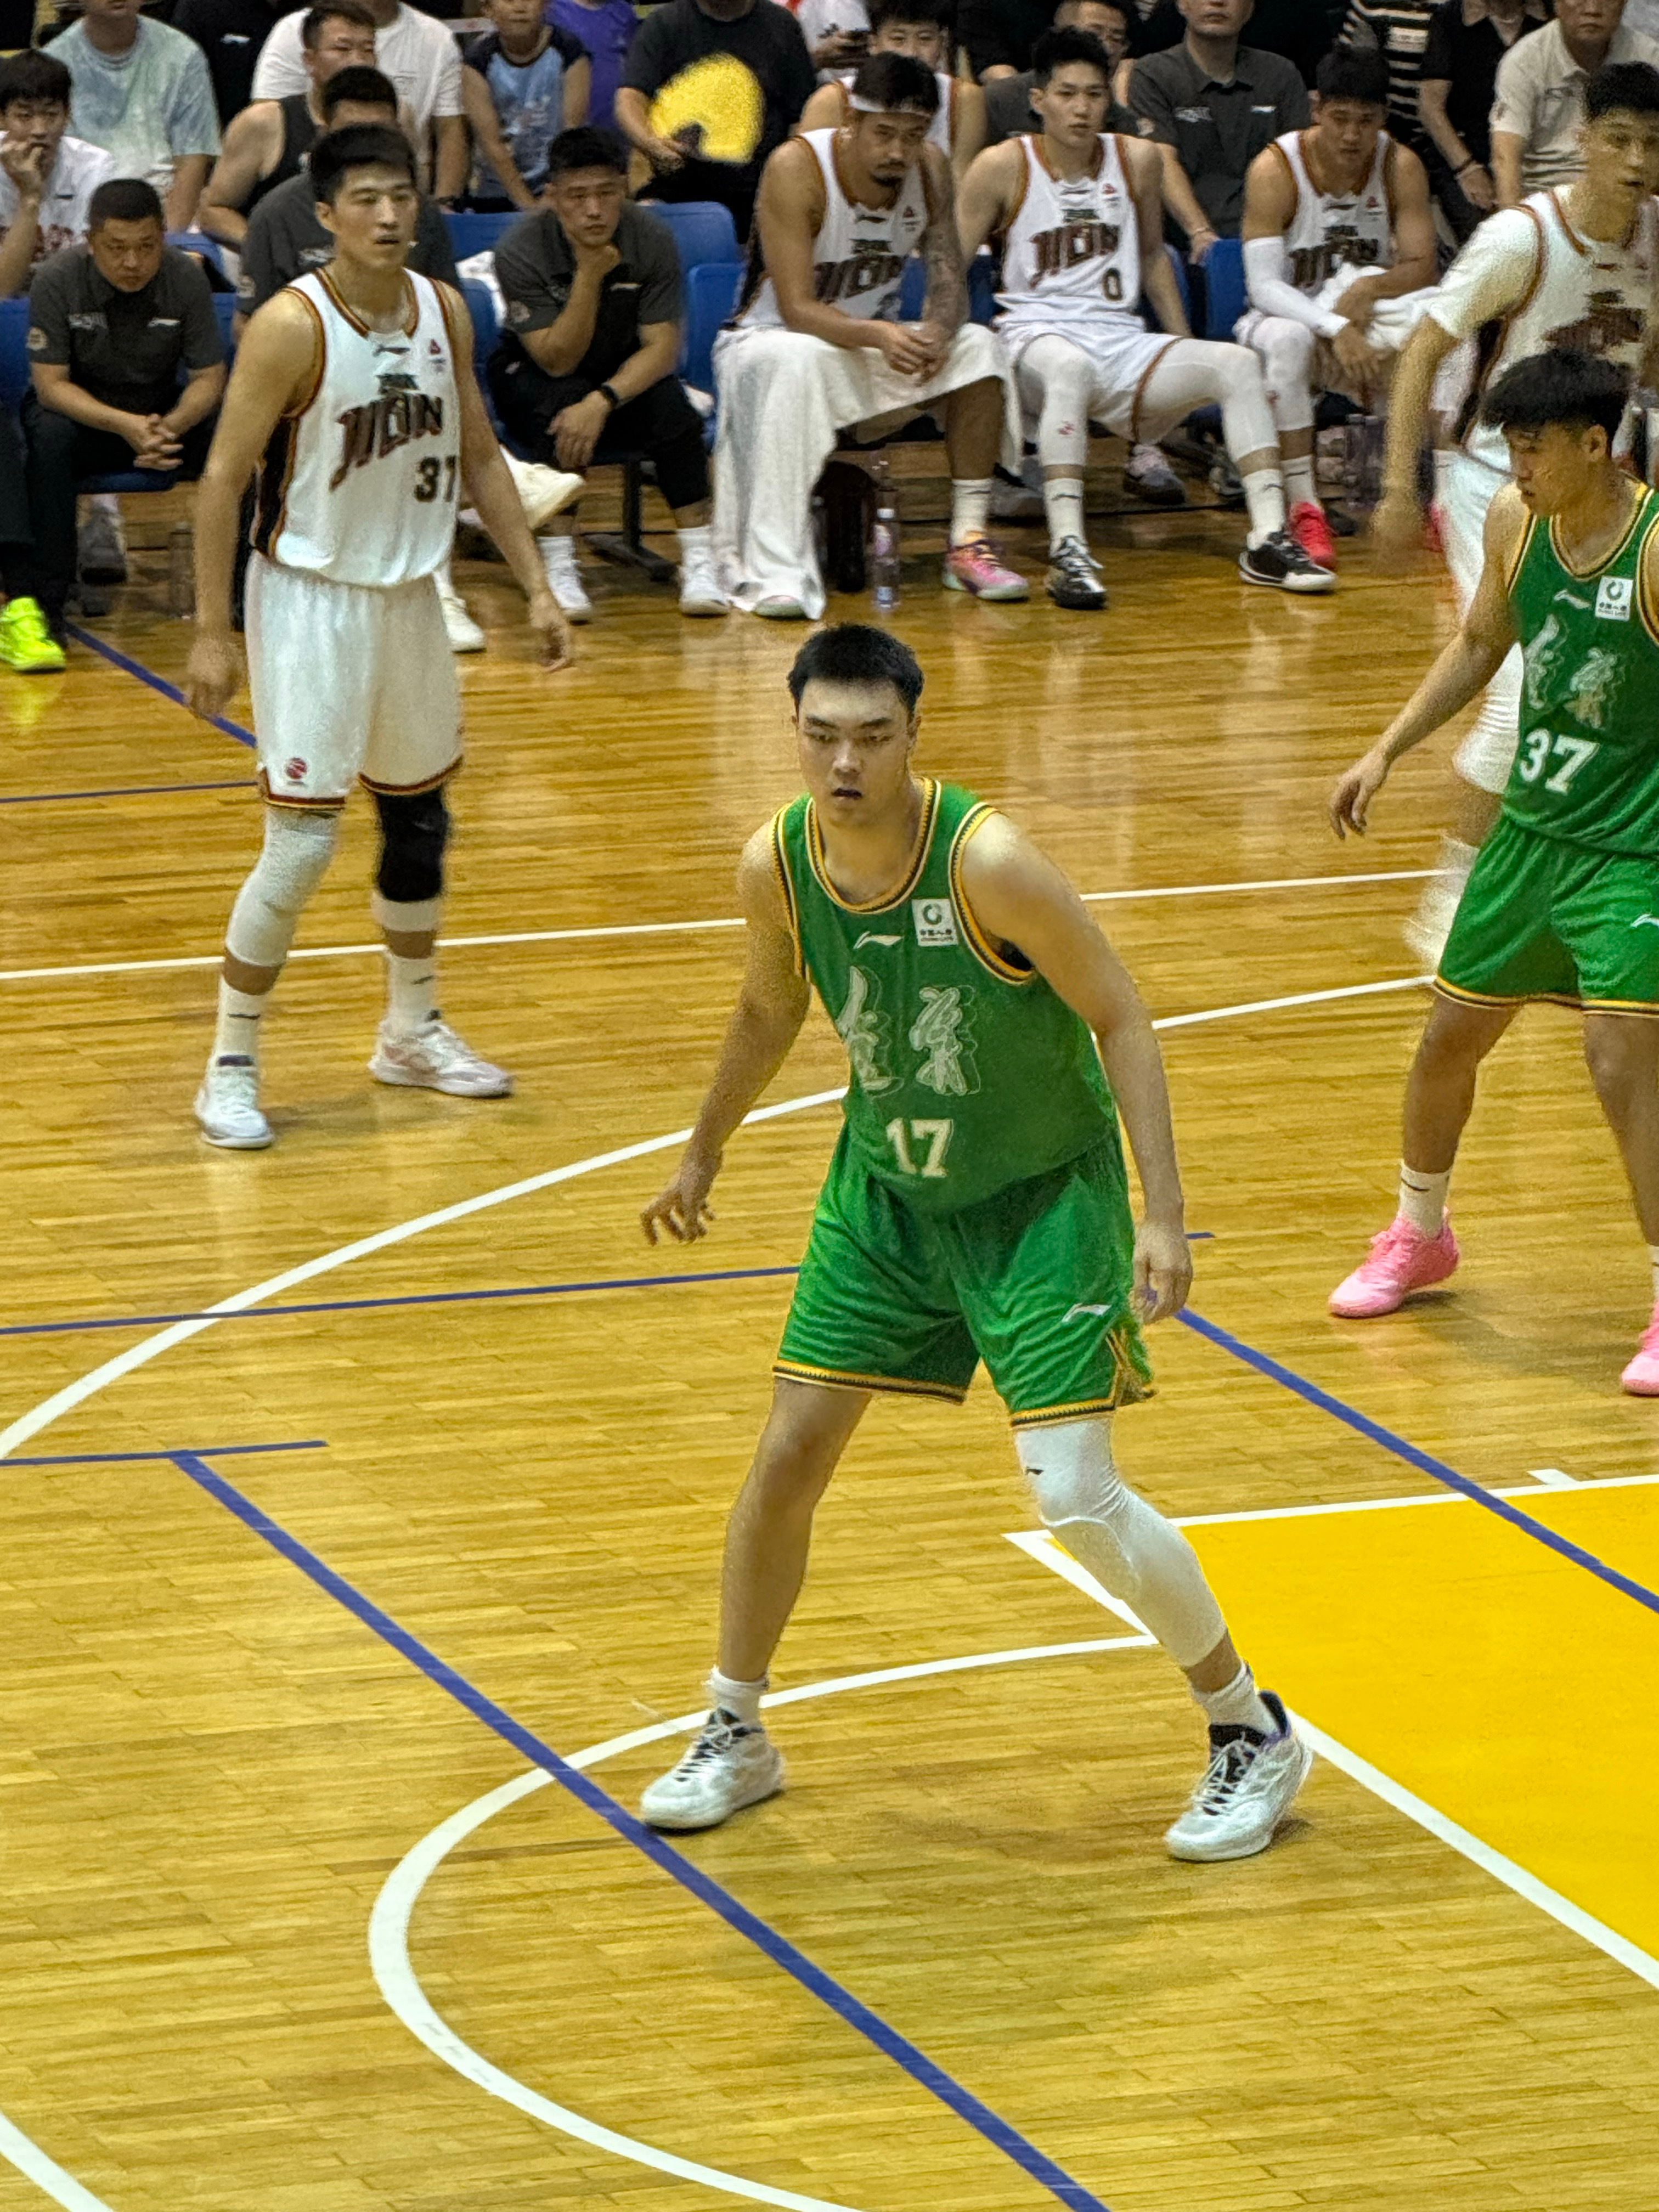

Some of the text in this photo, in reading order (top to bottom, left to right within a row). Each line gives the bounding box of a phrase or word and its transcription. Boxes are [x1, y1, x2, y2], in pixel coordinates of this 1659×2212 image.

[1103, 268, 1122, 301] 0
[1519, 728, 1600, 796] 37
[886, 1117, 954, 1178] 17
